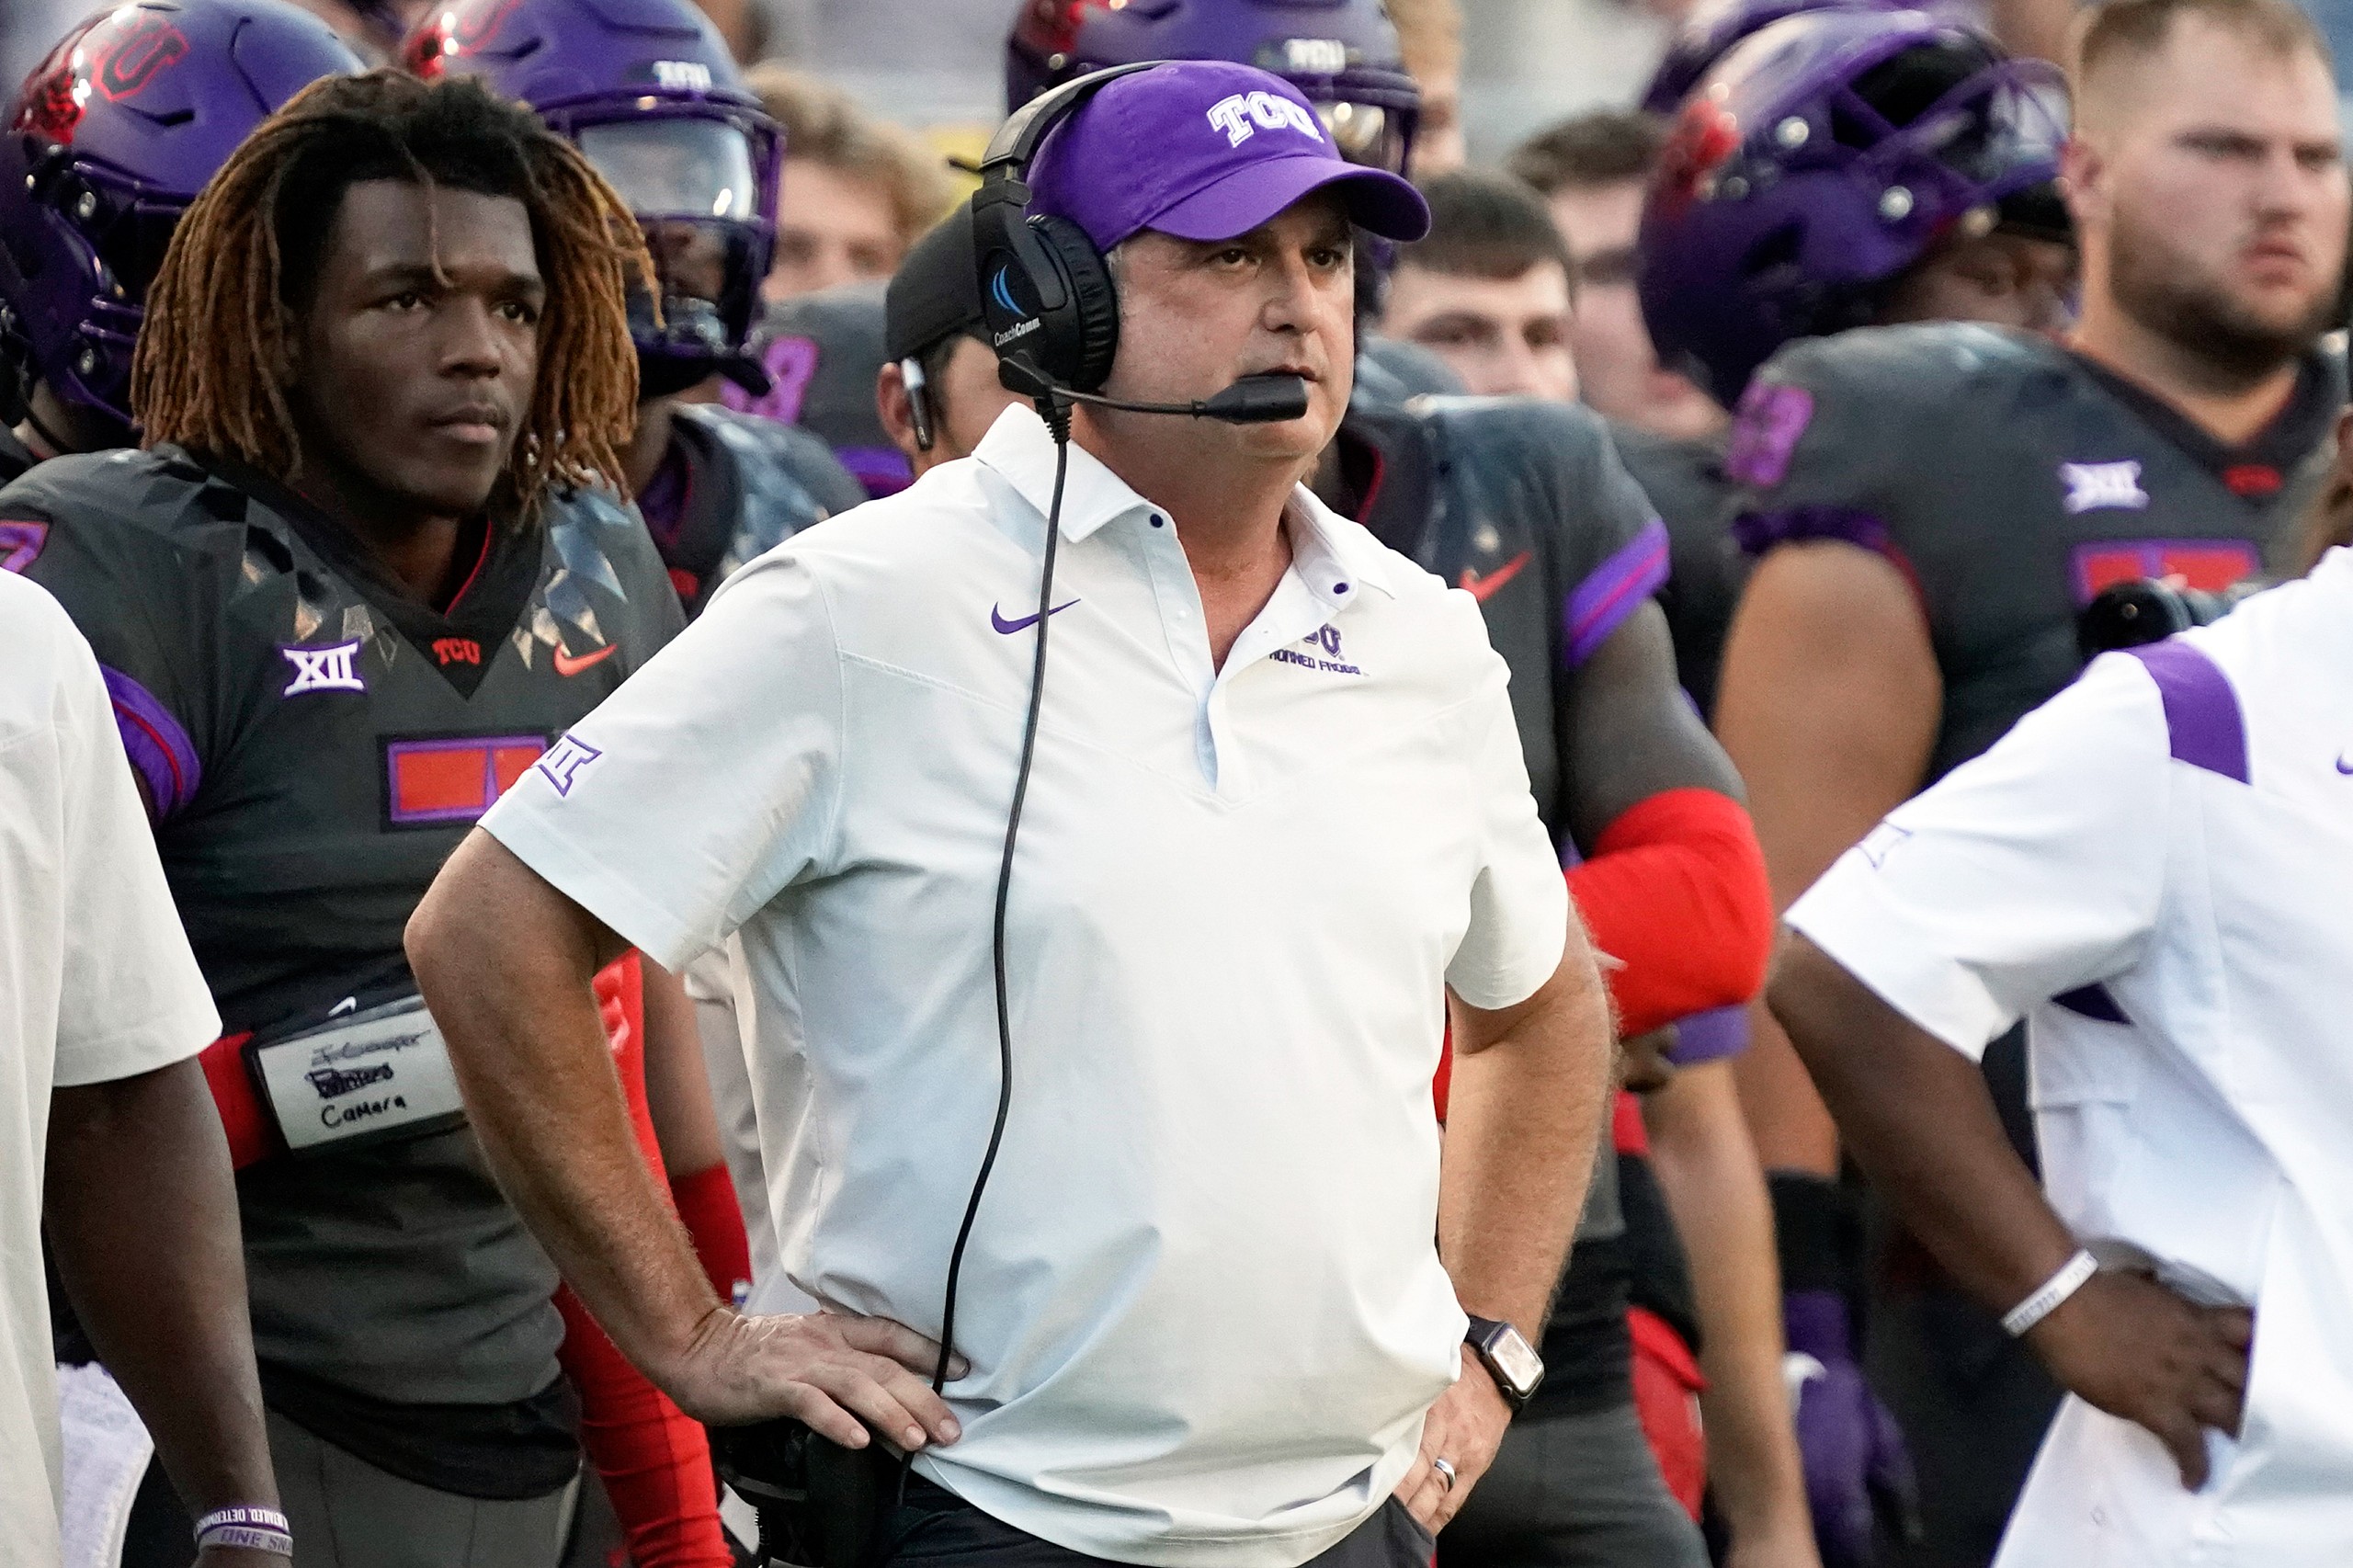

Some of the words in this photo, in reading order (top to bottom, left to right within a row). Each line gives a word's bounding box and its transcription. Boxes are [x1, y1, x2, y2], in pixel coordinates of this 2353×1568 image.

[1207, 91, 1324, 148] TCU
[283, 642, 365, 696] XII
[432, 638, 481, 665] TCU
